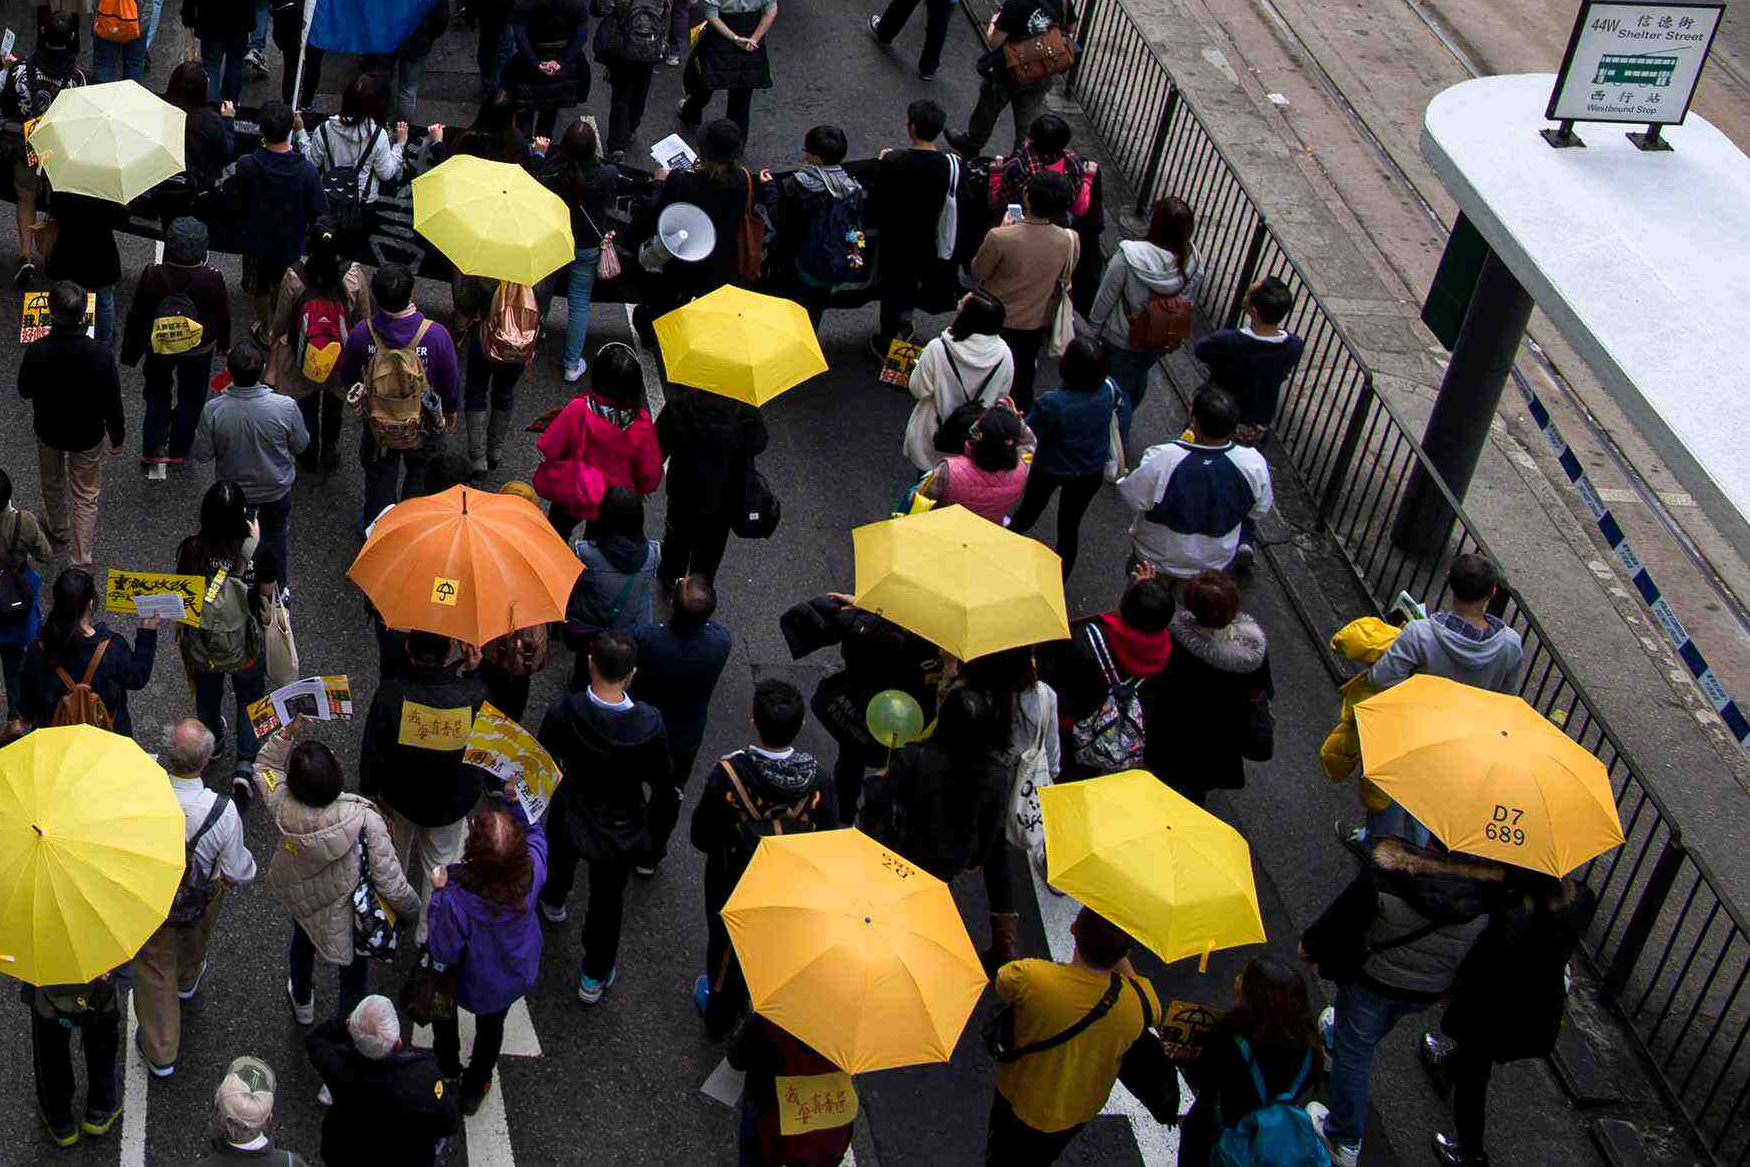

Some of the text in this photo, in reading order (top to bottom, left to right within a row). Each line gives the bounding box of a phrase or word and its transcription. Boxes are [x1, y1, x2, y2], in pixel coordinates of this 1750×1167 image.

[1591, 17, 1621, 32] 44W
[1636, 15, 1696, 30] 信德街
[1617, 30, 1705, 41] Shelter Street
[1591, 91, 1662, 104] 西行站
[1586, 104, 1658, 115] Westbound Stop
[1485, 823, 1527, 846] 689
